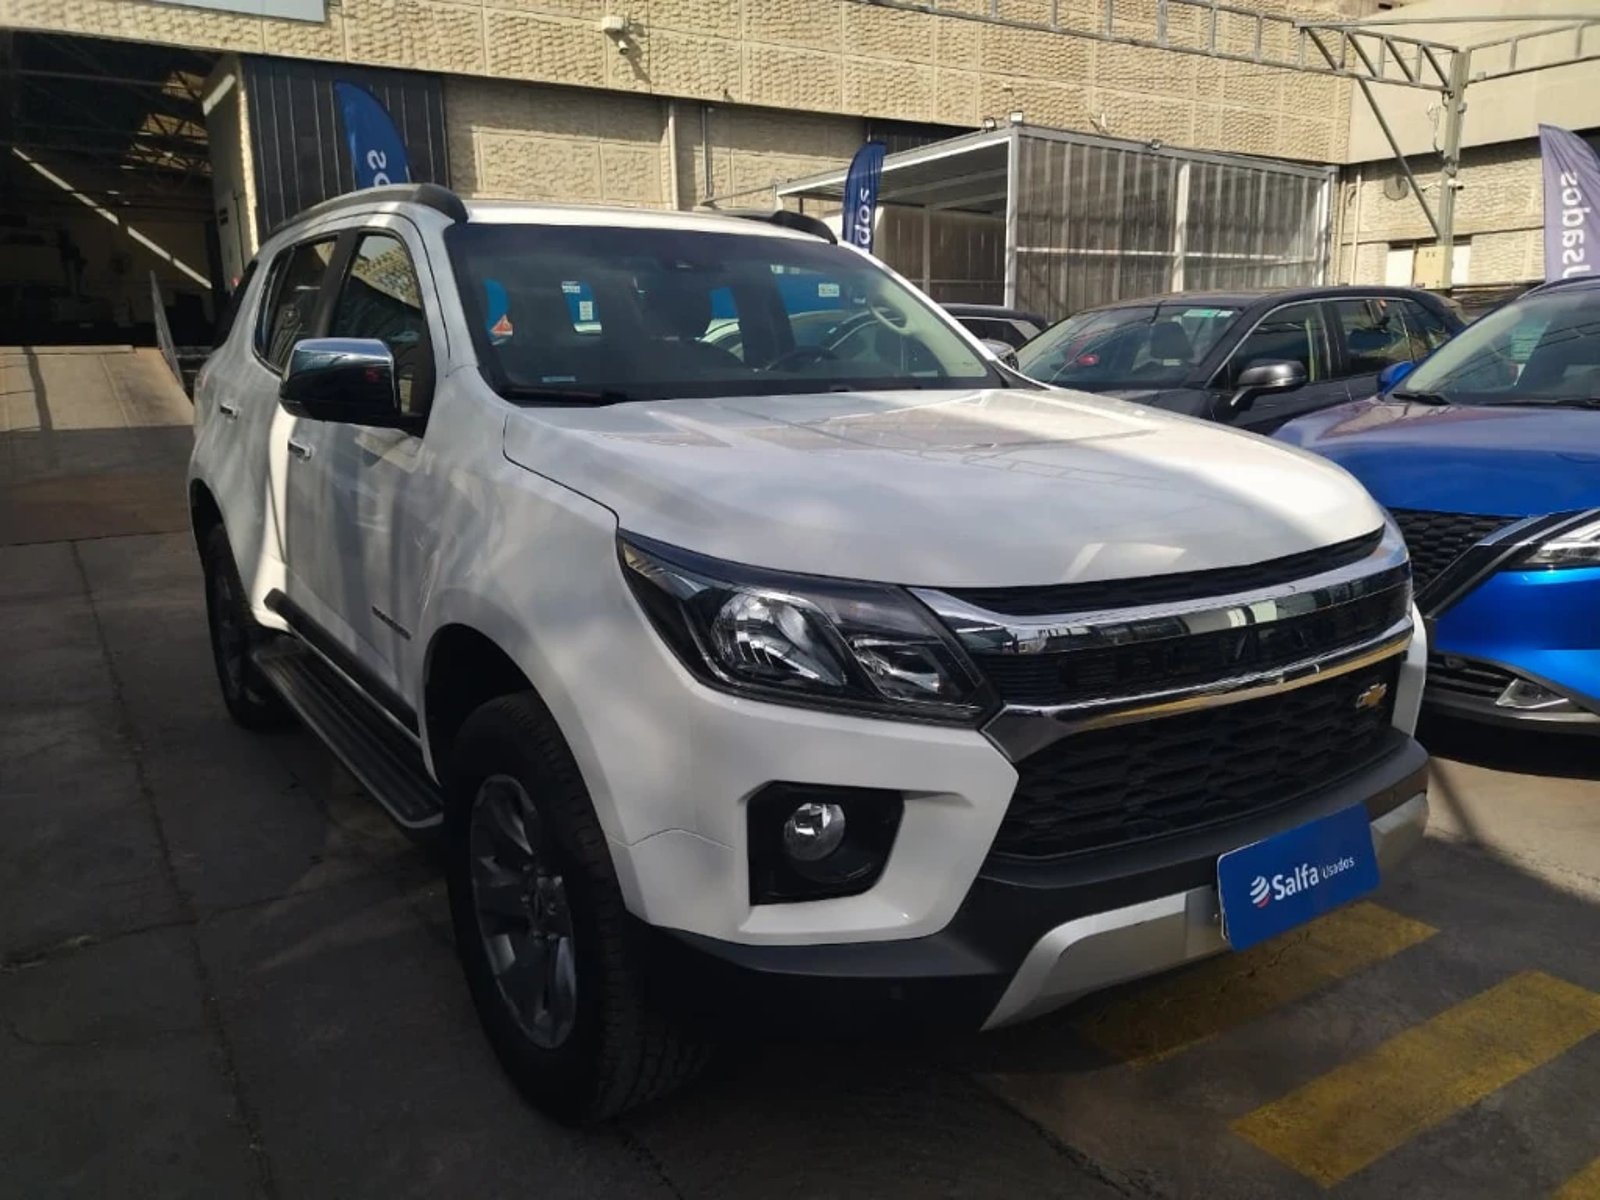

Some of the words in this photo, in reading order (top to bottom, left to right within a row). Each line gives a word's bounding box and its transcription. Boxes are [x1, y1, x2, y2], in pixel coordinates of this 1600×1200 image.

[855, 187, 870, 253] dos
[1272, 863, 1320, 901] Salfa
[1321, 856, 1355, 879] Usados
